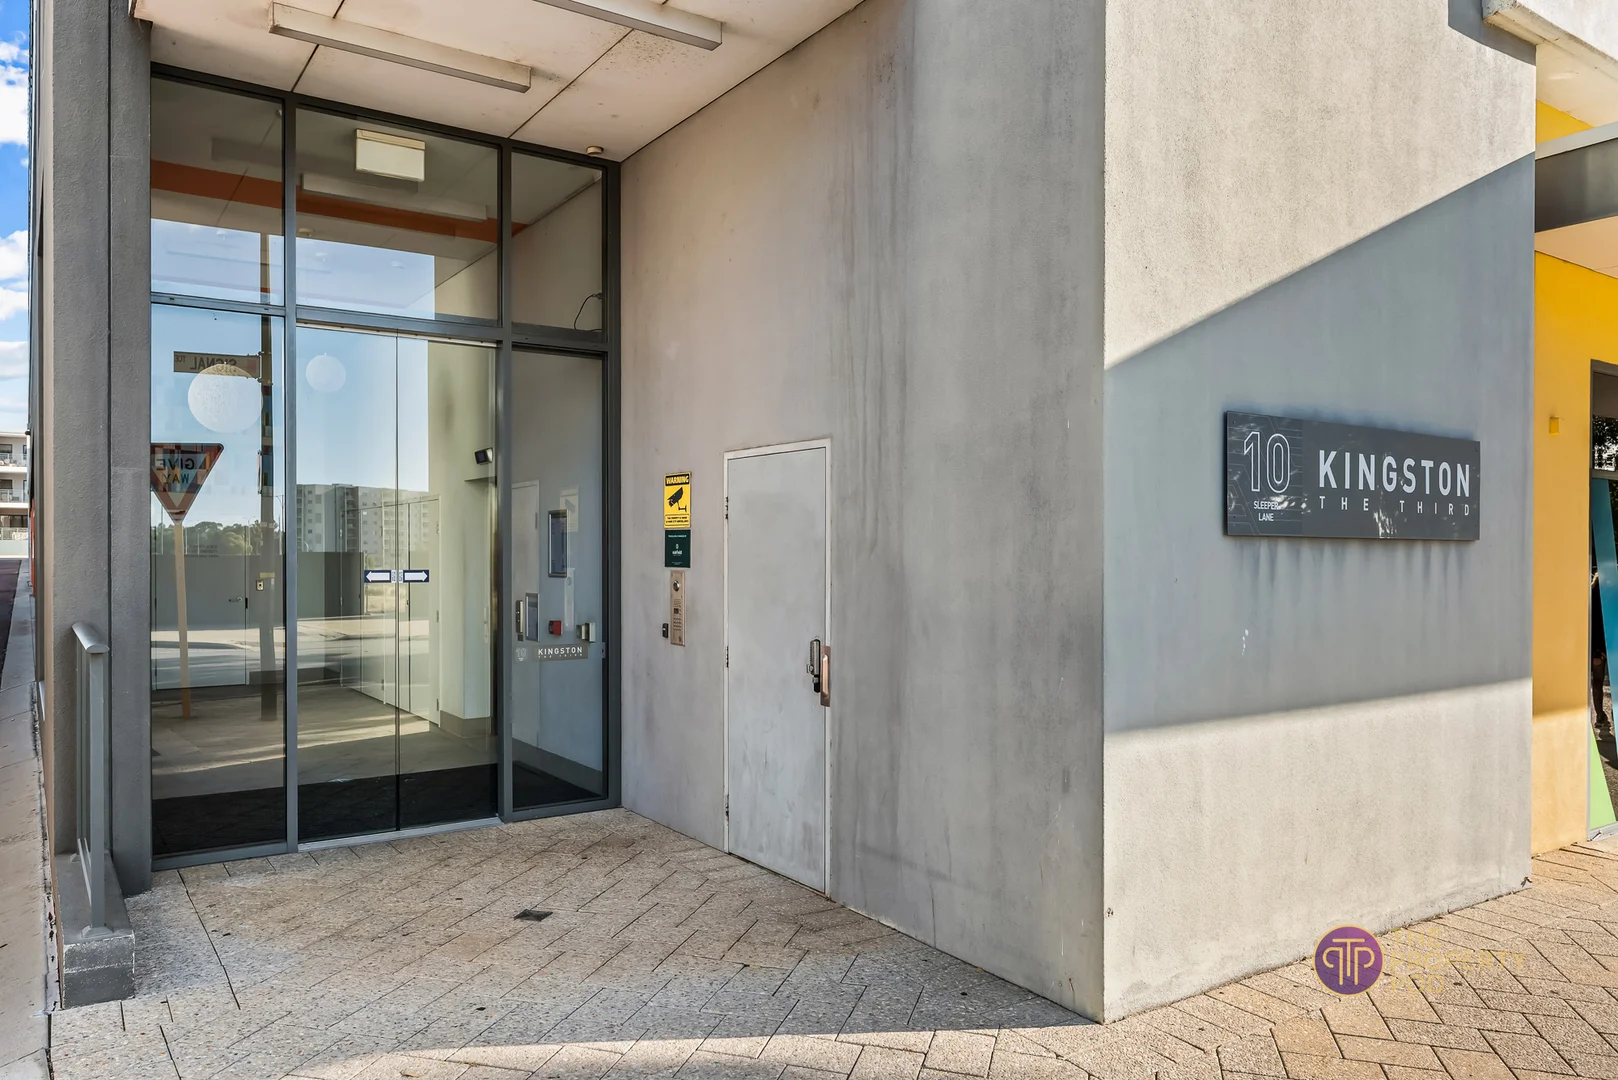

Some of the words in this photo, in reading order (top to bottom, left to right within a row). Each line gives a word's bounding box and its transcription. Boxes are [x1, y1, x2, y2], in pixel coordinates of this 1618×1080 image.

[1243, 431, 1290, 494] 10
[1319, 449, 1470, 498] KINGSTON
[666, 475, 689, 485] WARNING
[1253, 500, 1281, 510] SLEEPER
[1319, 495, 1369, 512] THE
[1399, 500, 1470, 516] THIRD
[1258, 512, 1274, 522] LANE
[538, 646, 583, 655] KINGSTON
